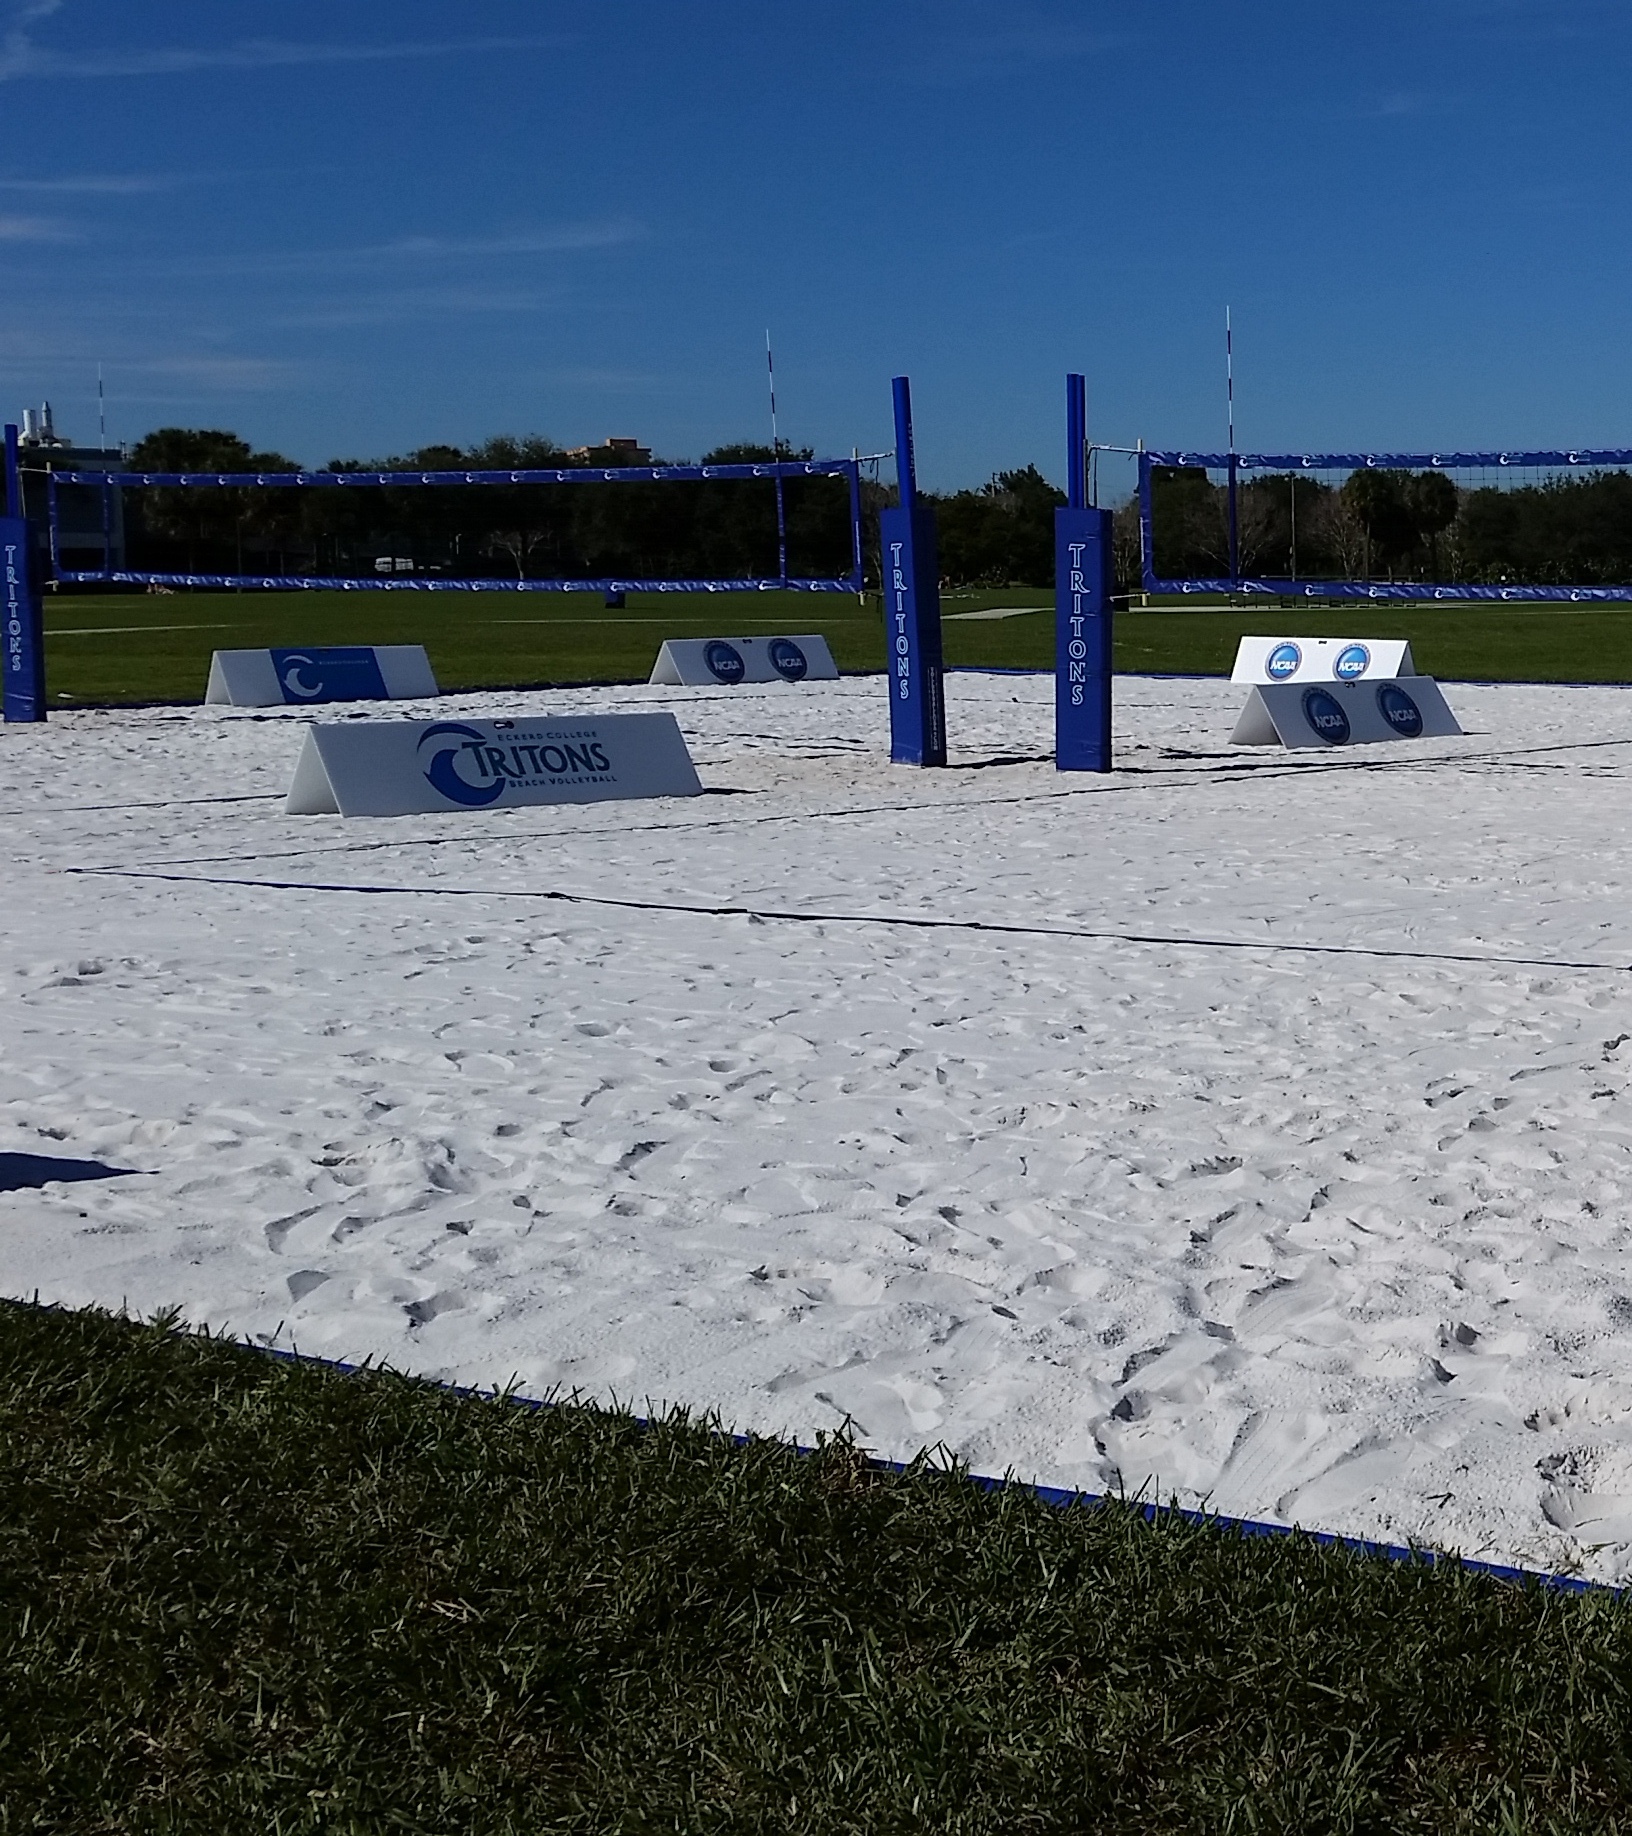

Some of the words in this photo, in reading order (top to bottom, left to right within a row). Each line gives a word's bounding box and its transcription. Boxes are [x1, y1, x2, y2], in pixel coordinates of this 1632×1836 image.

[5, 545, 22, 671] TRITONS
[889, 543, 909, 700] TRITONS
[1068, 543, 1091, 705] TRITONS
[714, 660, 740, 671] NCAA
[778, 658, 803, 668] NCAA
[1270, 660, 1298, 670] NCAA
[1337, 662, 1365, 672] NCAA
[1314, 714, 1344, 728] NCAA
[1389, 709, 1418, 722] NCAA
[497, 732, 543, 741] ECKERD
[546, 731, 598, 739] COLLEGE
[461, 741, 611, 778] TRITONS
[508, 778, 546, 788] BEACH
[549, 775, 618, 785] VOLLEYBALL
